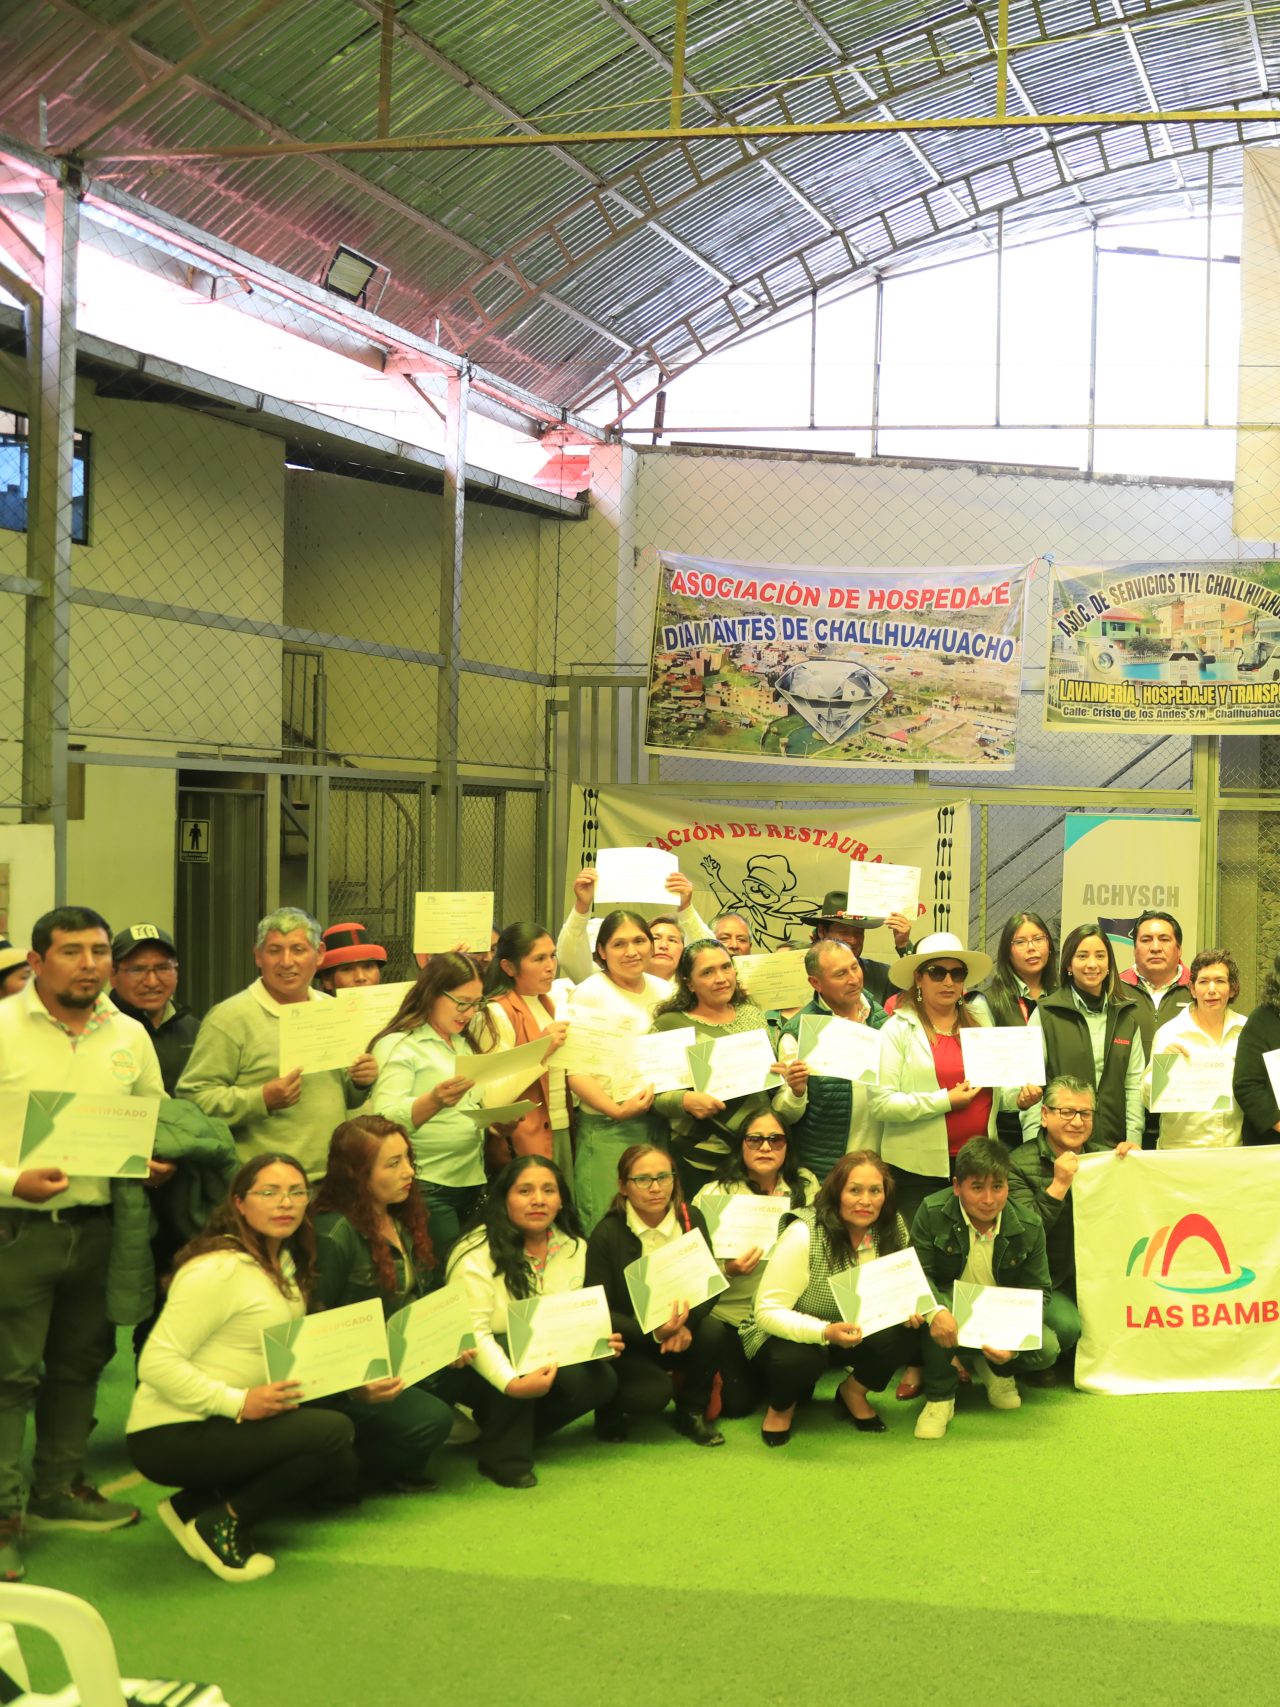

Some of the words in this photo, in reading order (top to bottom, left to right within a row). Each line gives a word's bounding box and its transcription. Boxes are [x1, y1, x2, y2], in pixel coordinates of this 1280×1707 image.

[671, 570, 821, 607] ASOCIACIÓN
[828, 588, 860, 609] DE
[868, 581, 1011, 610] HOSPEDAJE
[1057, 603, 1095, 638] ASOC.
[1089, 591, 1111, 614] DE
[1108, 574, 1176, 606] SERVICIOS
[1179, 572, 1201, 594] TYL
[664, 617, 776, 651] DIAMANTES
[783, 616, 808, 640] DE
[814, 618, 1014, 664] CHALLHUAHUACHO
[1143, 684, 1216, 705] HOSPEDAJE
[1218, 684, 1229, 705] Y
[1092, 707, 1121, 719] Cristo
[1124, 708, 1136, 719] de
[1138, 708, 1154, 719] los
[1156, 708, 1186, 719] Andes
[727, 822, 761, 838] DE
[1082, 884, 1180, 907] ACHYSCH
[1126, 1305, 1184, 1329] LAS
